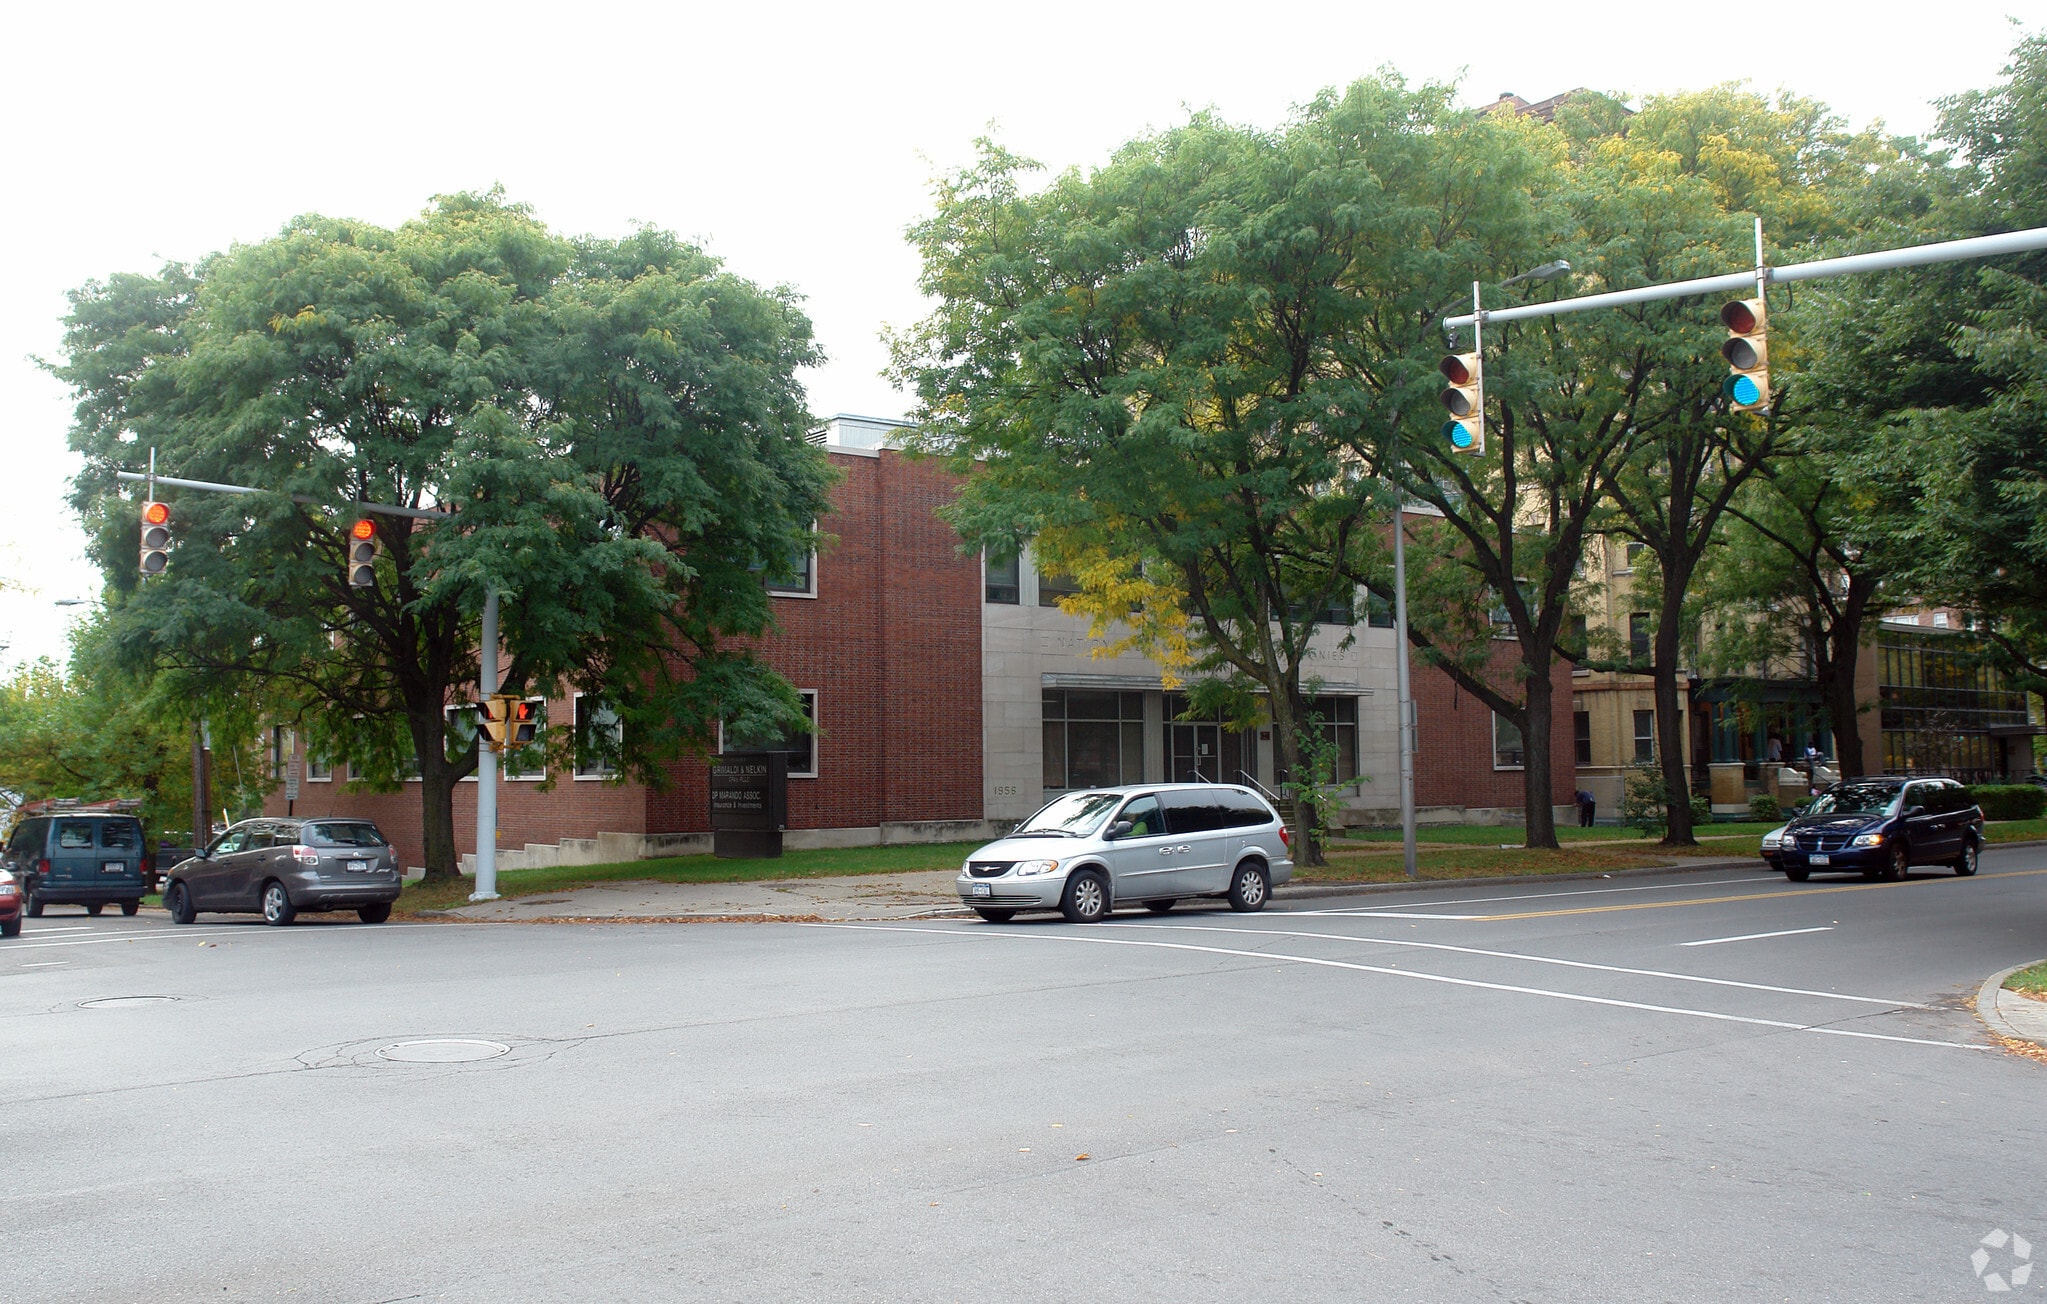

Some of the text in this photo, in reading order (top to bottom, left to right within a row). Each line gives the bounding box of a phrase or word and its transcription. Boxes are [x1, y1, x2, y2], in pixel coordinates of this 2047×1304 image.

[712, 765, 767, 774] GRIMALDI & NELKIN
[719, 791, 742, 799] MARANDO
